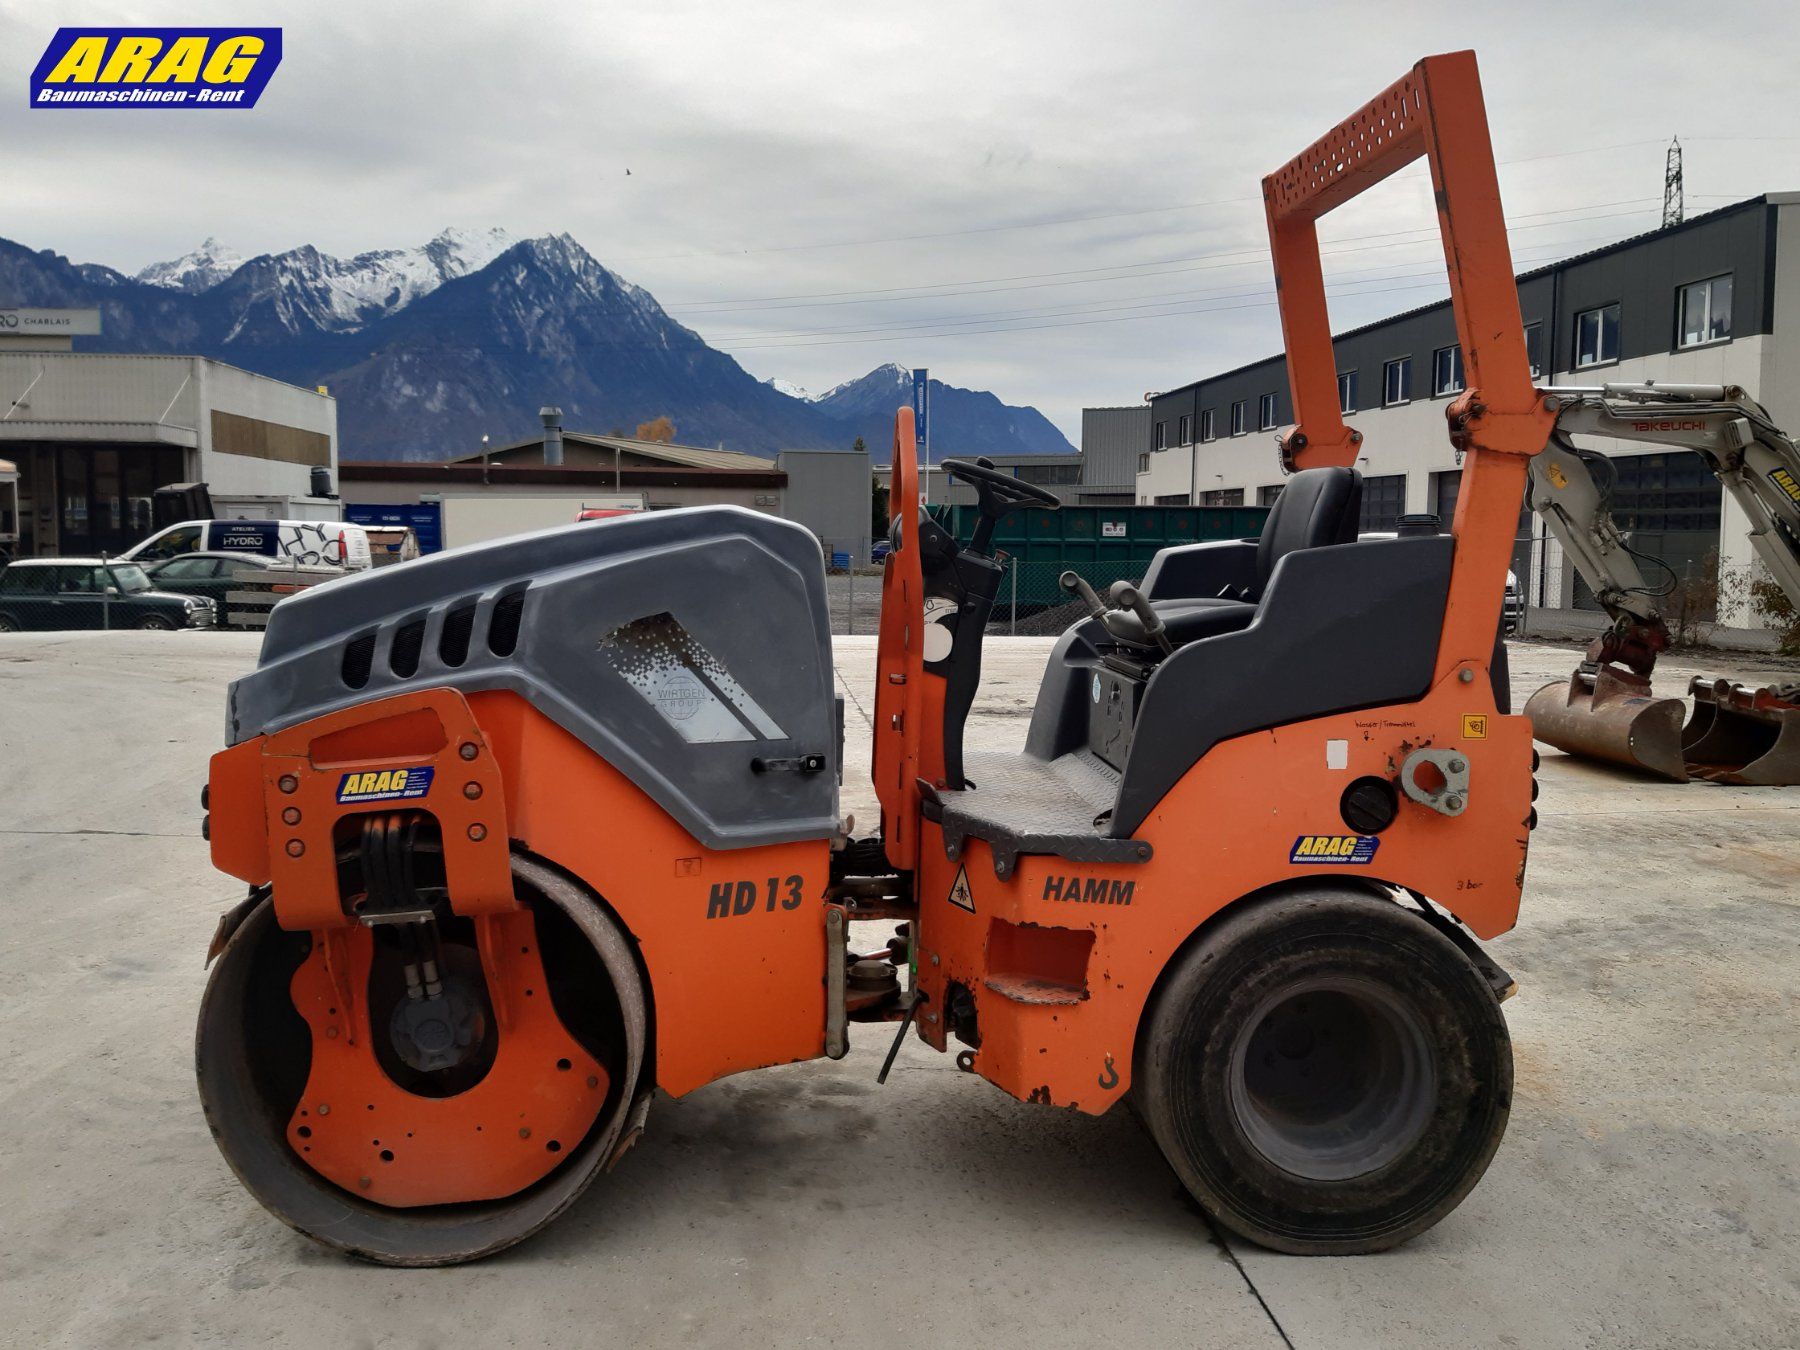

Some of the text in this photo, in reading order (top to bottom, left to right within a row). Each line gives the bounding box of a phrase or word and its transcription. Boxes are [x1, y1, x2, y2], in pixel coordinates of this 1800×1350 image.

[223, 536, 264, 546] HYDRO
[658, 688, 706, 698] WIRTGEN
[342, 770, 409, 795] ARAG
[1295, 836, 1357, 855] ARAG
[706, 874, 804, 920] HD 13
[1042, 876, 1136, 906] HAMM
